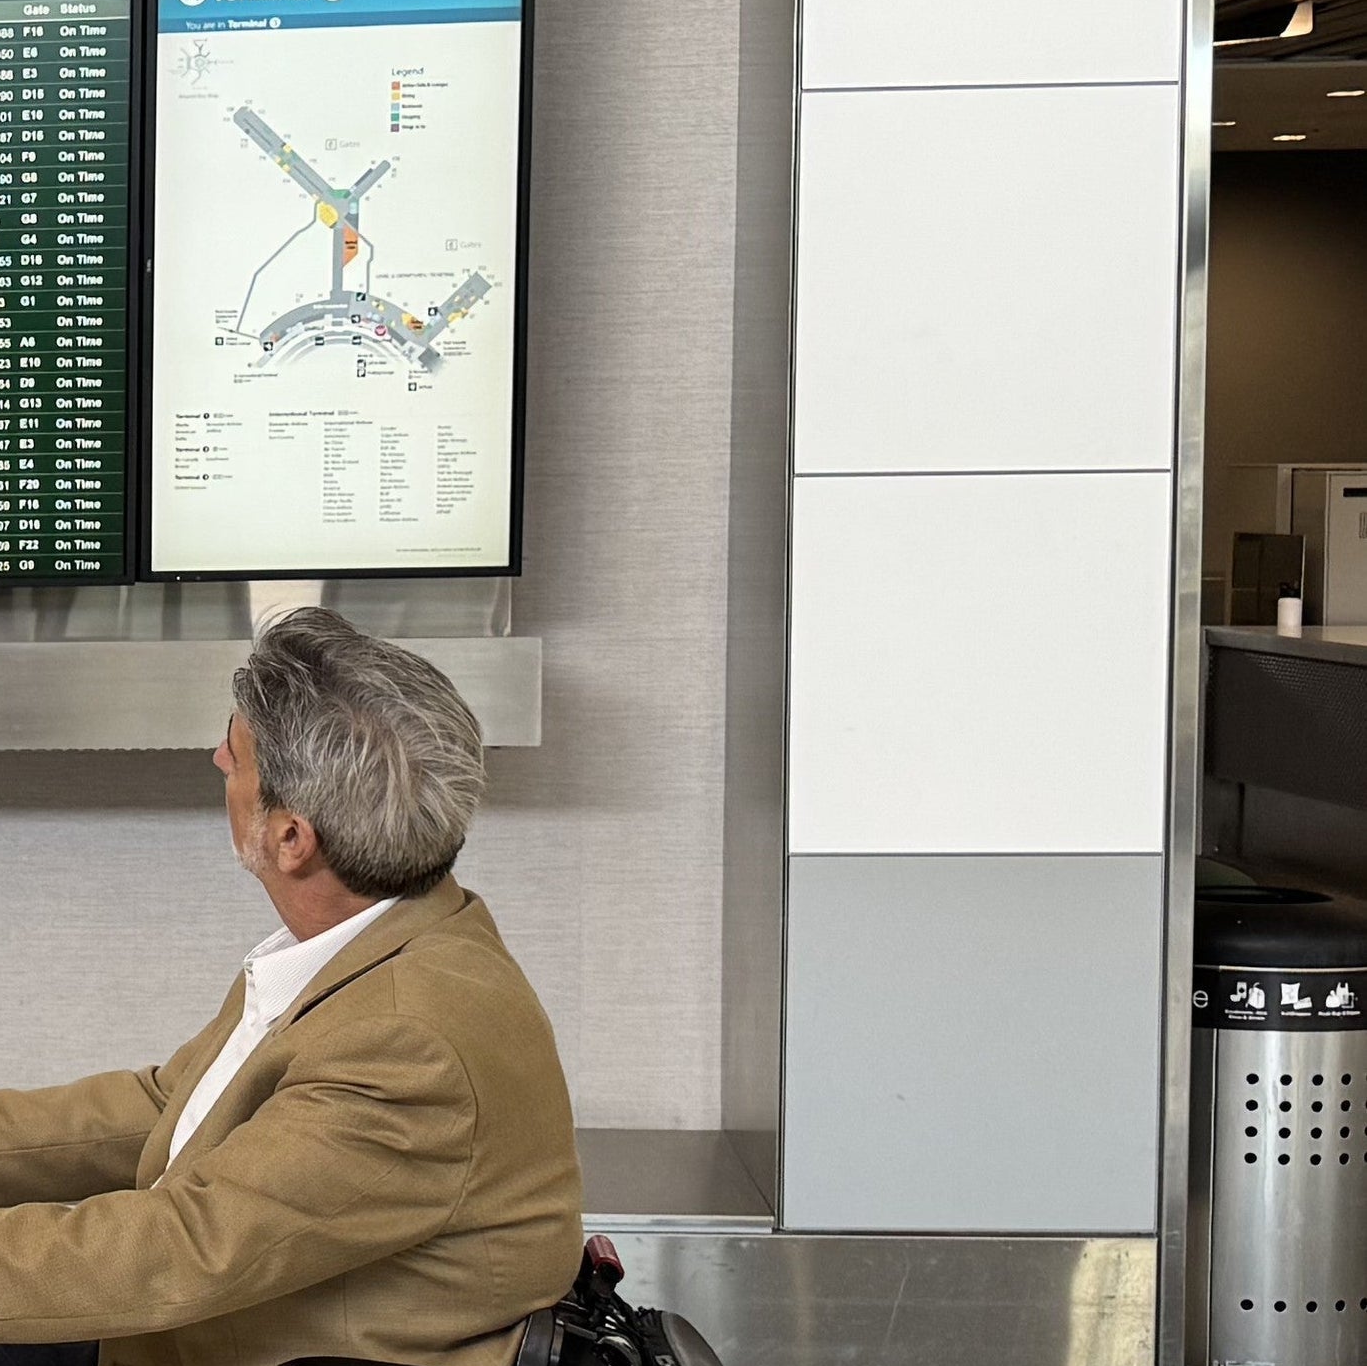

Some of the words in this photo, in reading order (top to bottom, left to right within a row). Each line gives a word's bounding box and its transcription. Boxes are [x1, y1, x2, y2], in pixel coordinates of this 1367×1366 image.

[23, 4, 49, 15] Gate
[60, 3, 96, 14] Status
[185, 21, 200, 30] You
[228, 19, 267, 29] Terminal
[59, 25, 76, 36] On
[79, 25, 106, 35] Time
[391, 67, 425, 77] Legend
